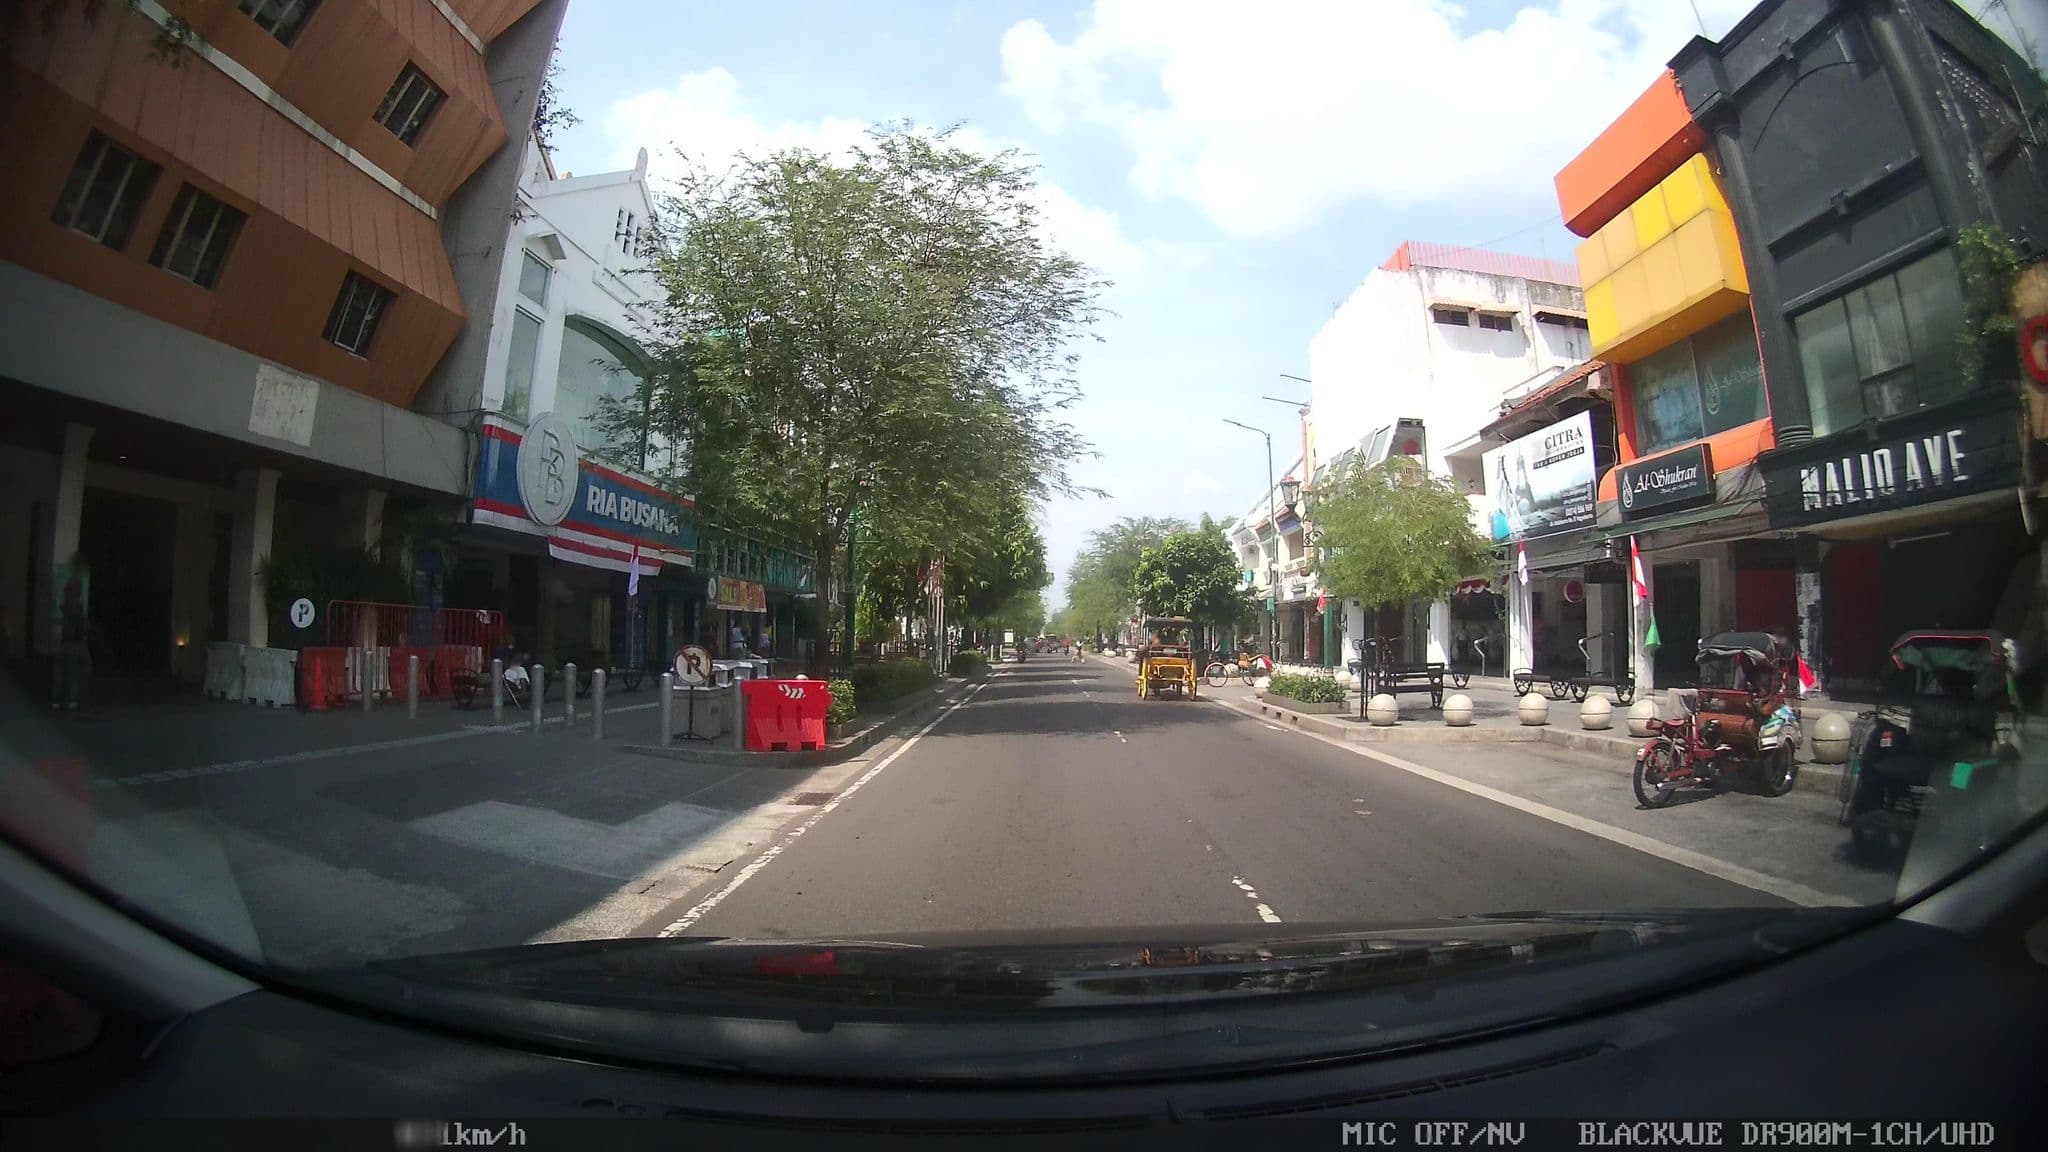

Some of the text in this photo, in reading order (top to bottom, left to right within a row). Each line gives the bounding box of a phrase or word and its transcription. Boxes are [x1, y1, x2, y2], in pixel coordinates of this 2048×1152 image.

[1545, 426, 1584, 450] CITRA
[1906, 429, 1969, 491] AVE
[1633, 464, 1697, 493] Al-Shukran
[586, 485, 618, 520] RIA
